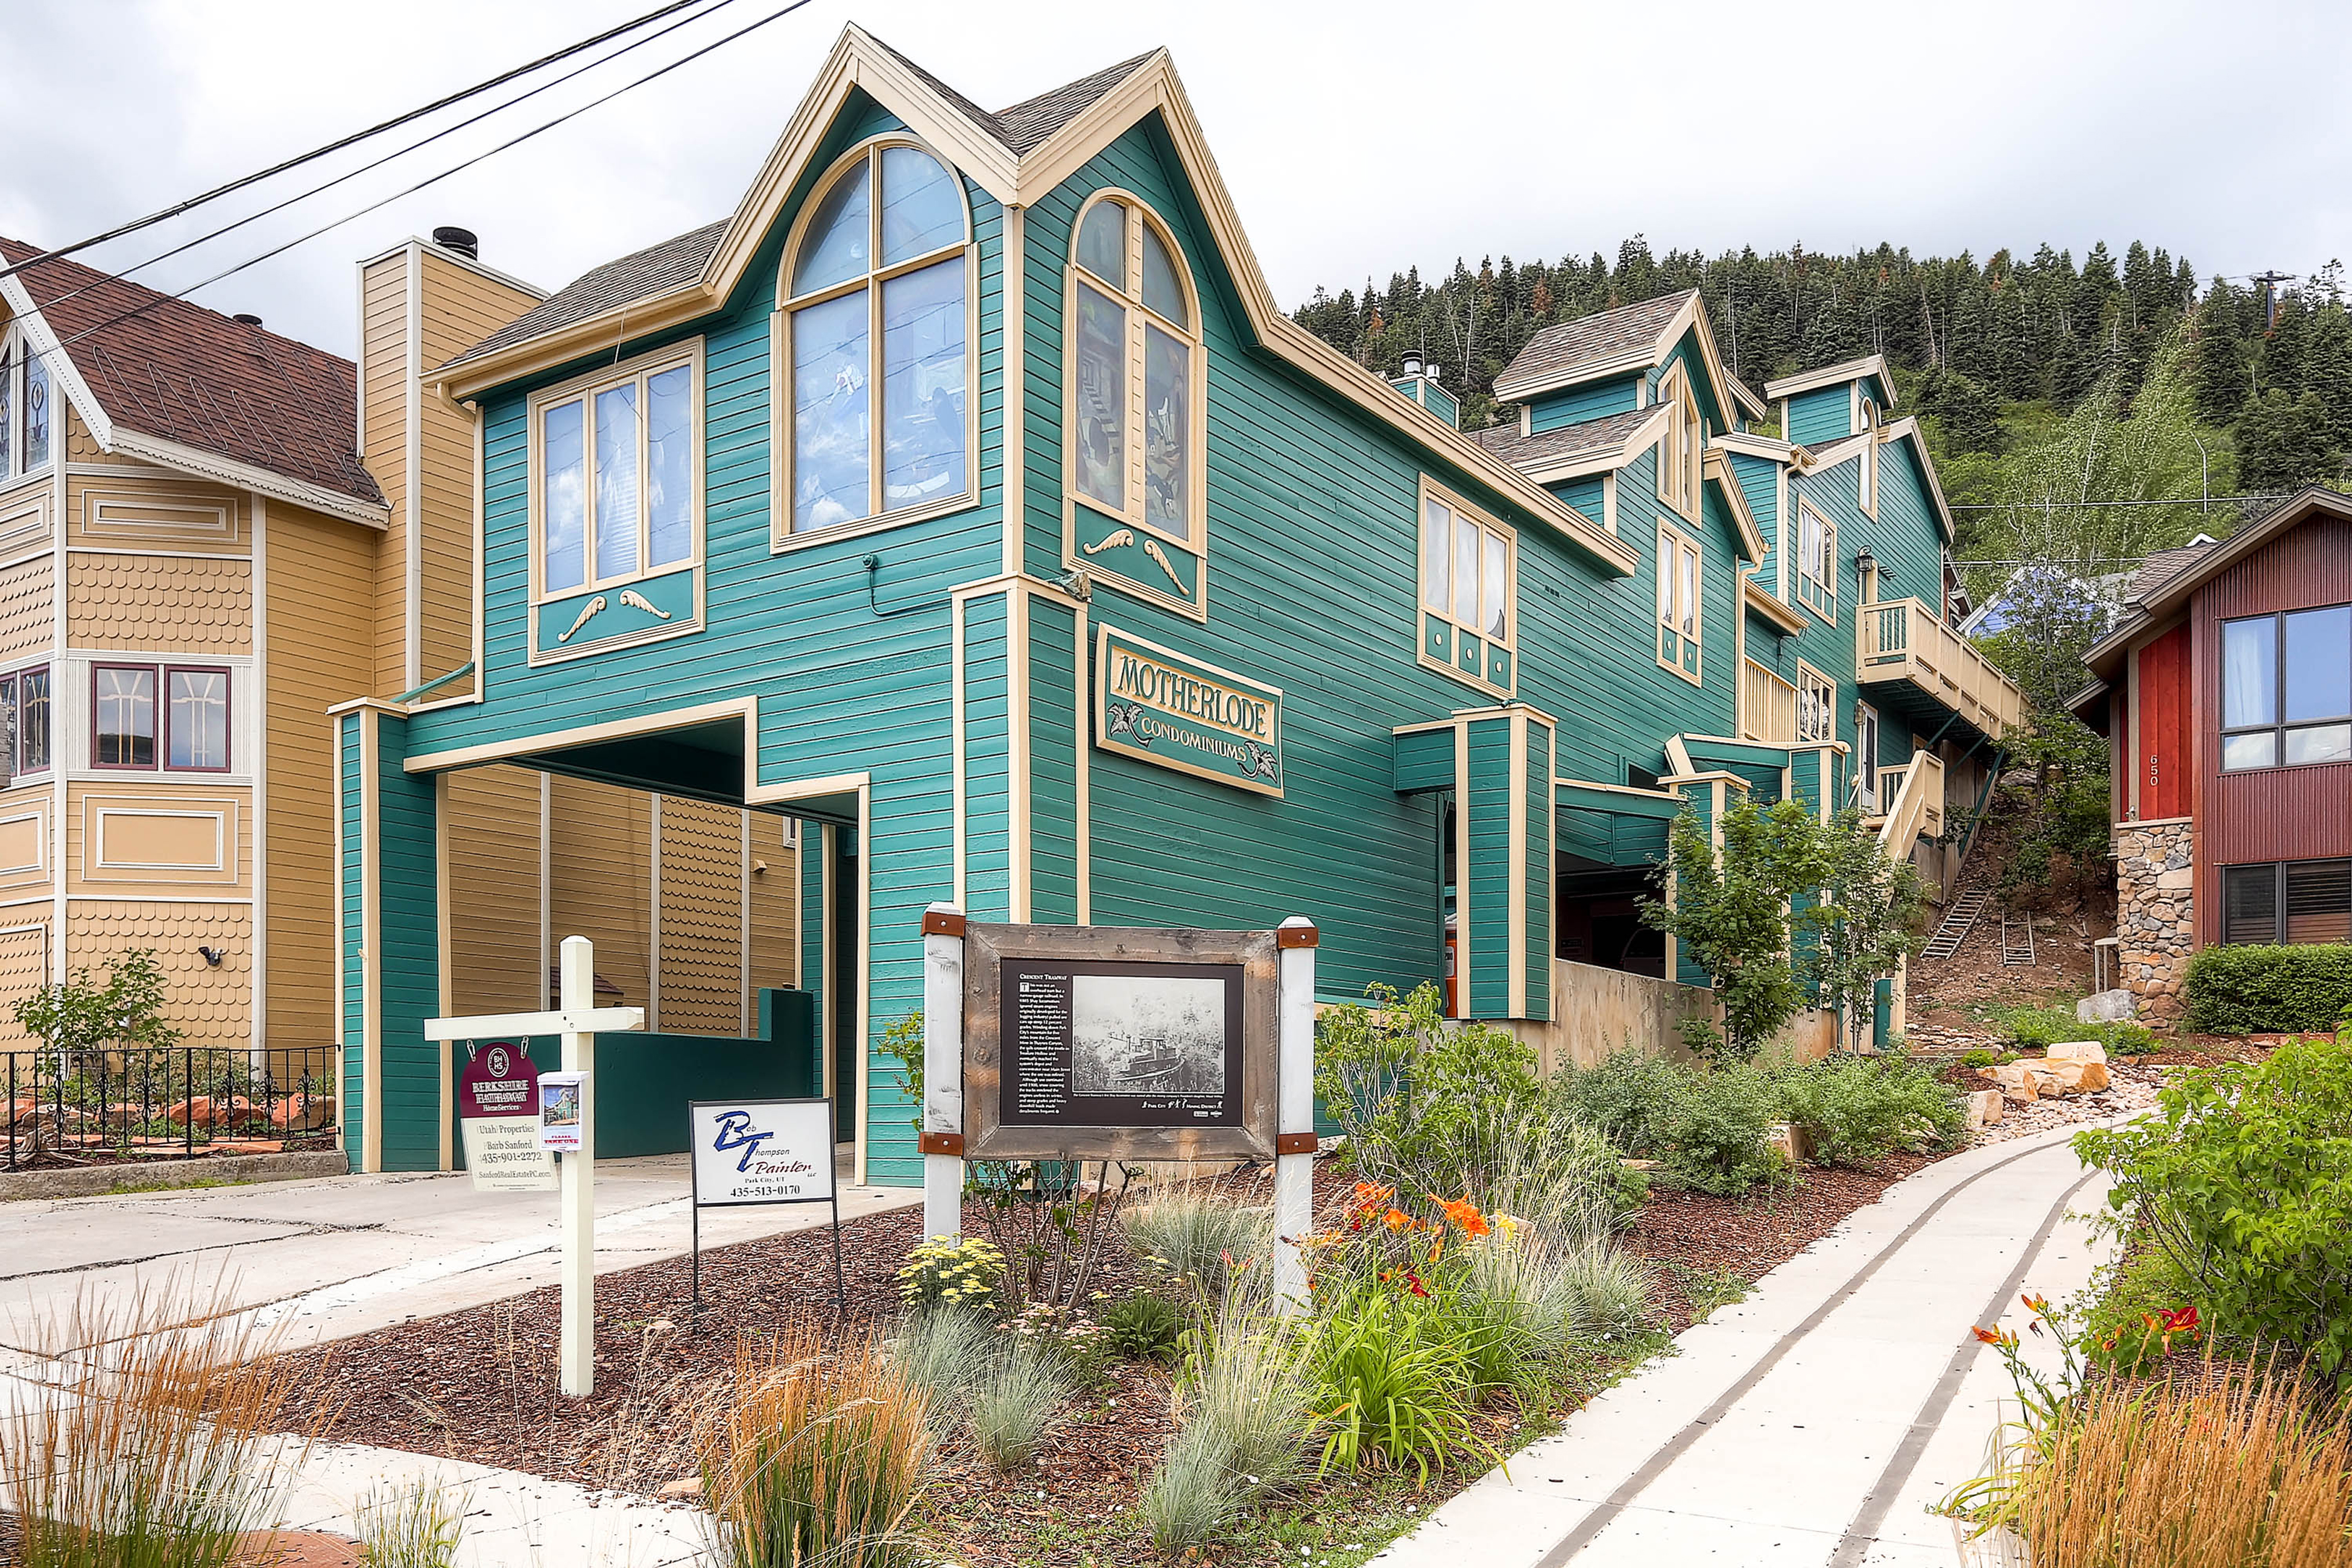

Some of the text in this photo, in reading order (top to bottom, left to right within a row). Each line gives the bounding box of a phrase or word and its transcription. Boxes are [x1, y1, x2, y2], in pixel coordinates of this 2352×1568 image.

[1118, 655, 1266, 738] MOTHERLODE
[1141, 717, 1247, 762] CONDOMINIUMS
[472, 1080, 530, 1093] BERKSHIRE
[479, 1124, 535, 1135] Utah Properties
[487, 1139, 533, 1150] Barb Sanford
[482, 1151, 542, 1164] 435-901-2272
[755, 1161, 812, 1174] Painter
[730, 1185, 800, 1197] 435-513-0170
